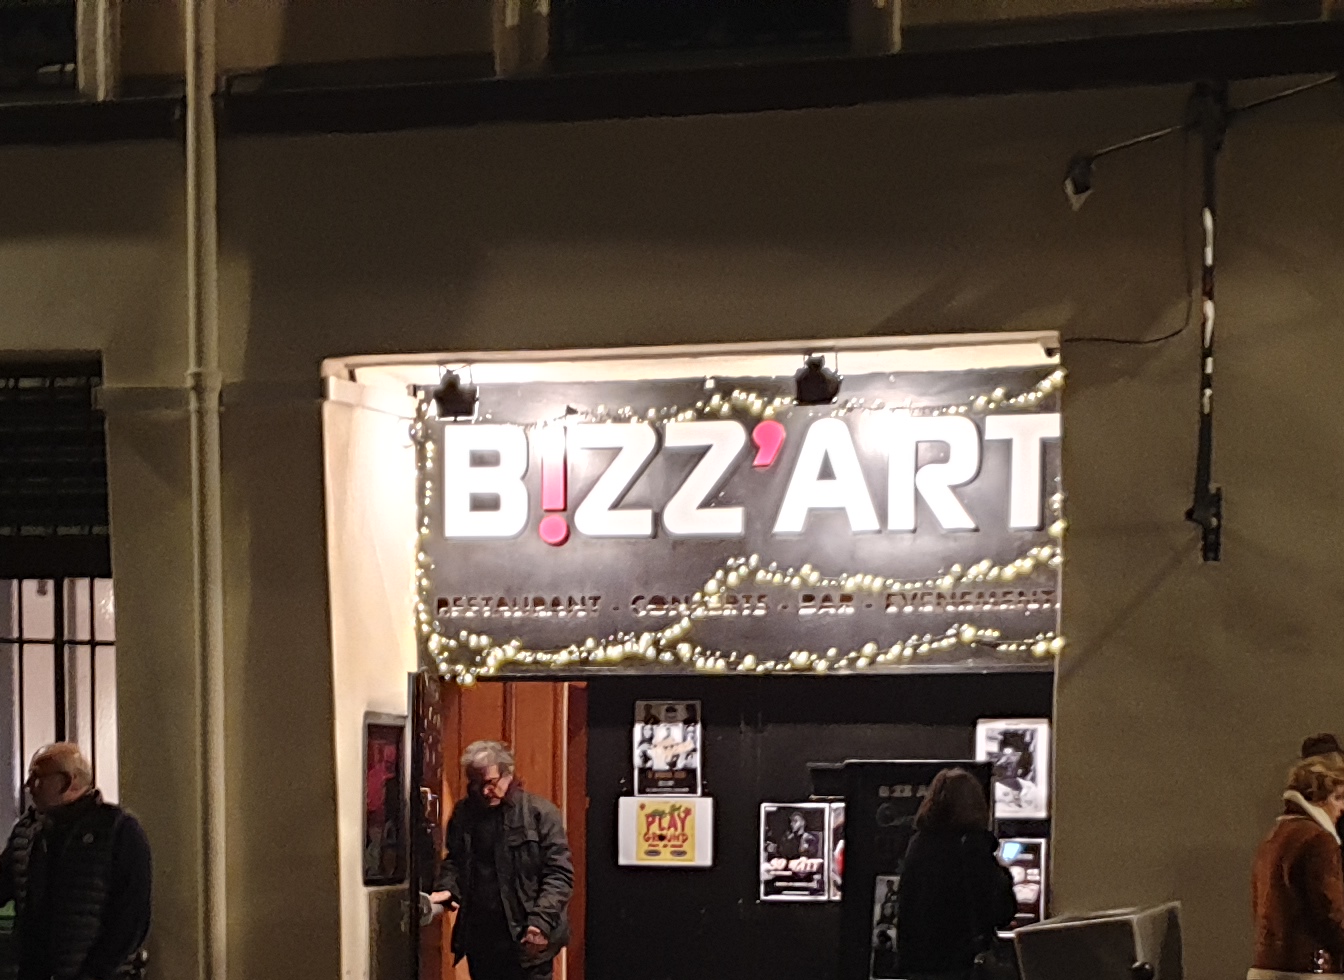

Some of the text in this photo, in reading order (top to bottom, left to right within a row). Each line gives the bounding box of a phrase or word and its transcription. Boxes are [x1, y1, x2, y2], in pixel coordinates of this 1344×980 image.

[435, 595, 602, 616] RESTAURANT
[798, 590, 854, 613] BAR
[646, 806, 691, 833] PLAY
